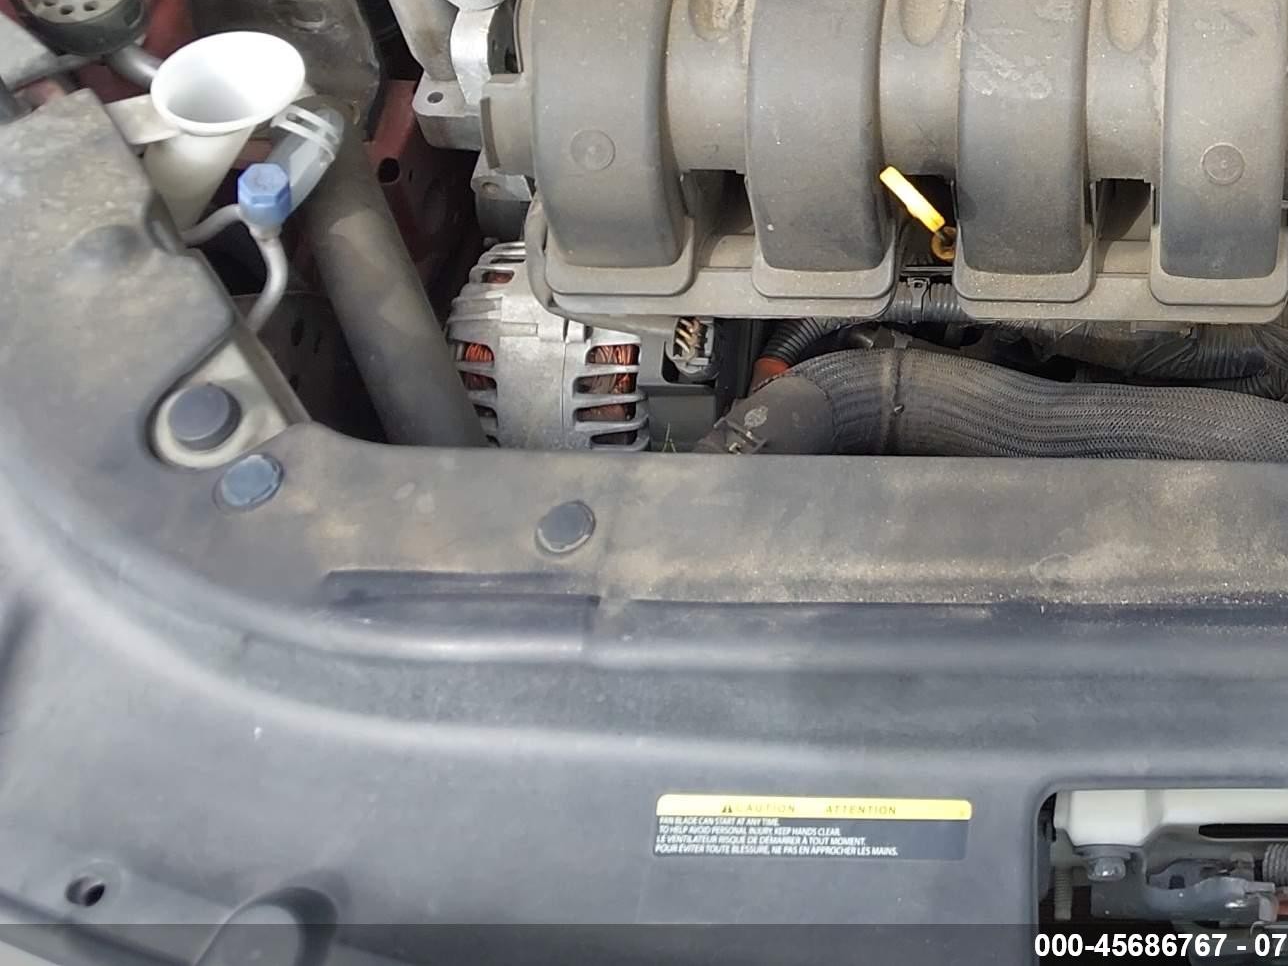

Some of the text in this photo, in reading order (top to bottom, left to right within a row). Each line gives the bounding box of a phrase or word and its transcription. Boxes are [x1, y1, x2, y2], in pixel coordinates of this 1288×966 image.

[736, 804, 896, 814] CAUTION ATTENTION
[699, 817, 714, 825] CAN
[715, 817, 736, 825] START
[659, 826, 669, 834] TO
[670, 826, 688, 834] HELP
[688, 826, 711, 834] AVOID
[712, 826, 747, 834] PERSONAL
[792, 827, 817, 835] HANDS
[656, 835, 666, 843] LE
[667, 835, 717, 843] VENTILATEUR
[718, 835, 745, 844] RISQUE
[809, 836, 829, 845] TOUT
[655, 844, 678, 853] POUR
[705, 844, 730, 853] TOUTE
[771, 845, 782, 854] NE
[783, 846, 798, 854] PAS
[798, 846, 810, 854] EN
[810, 846, 857, 855] APPROCHER
[857, 846, 871, 855] LES
